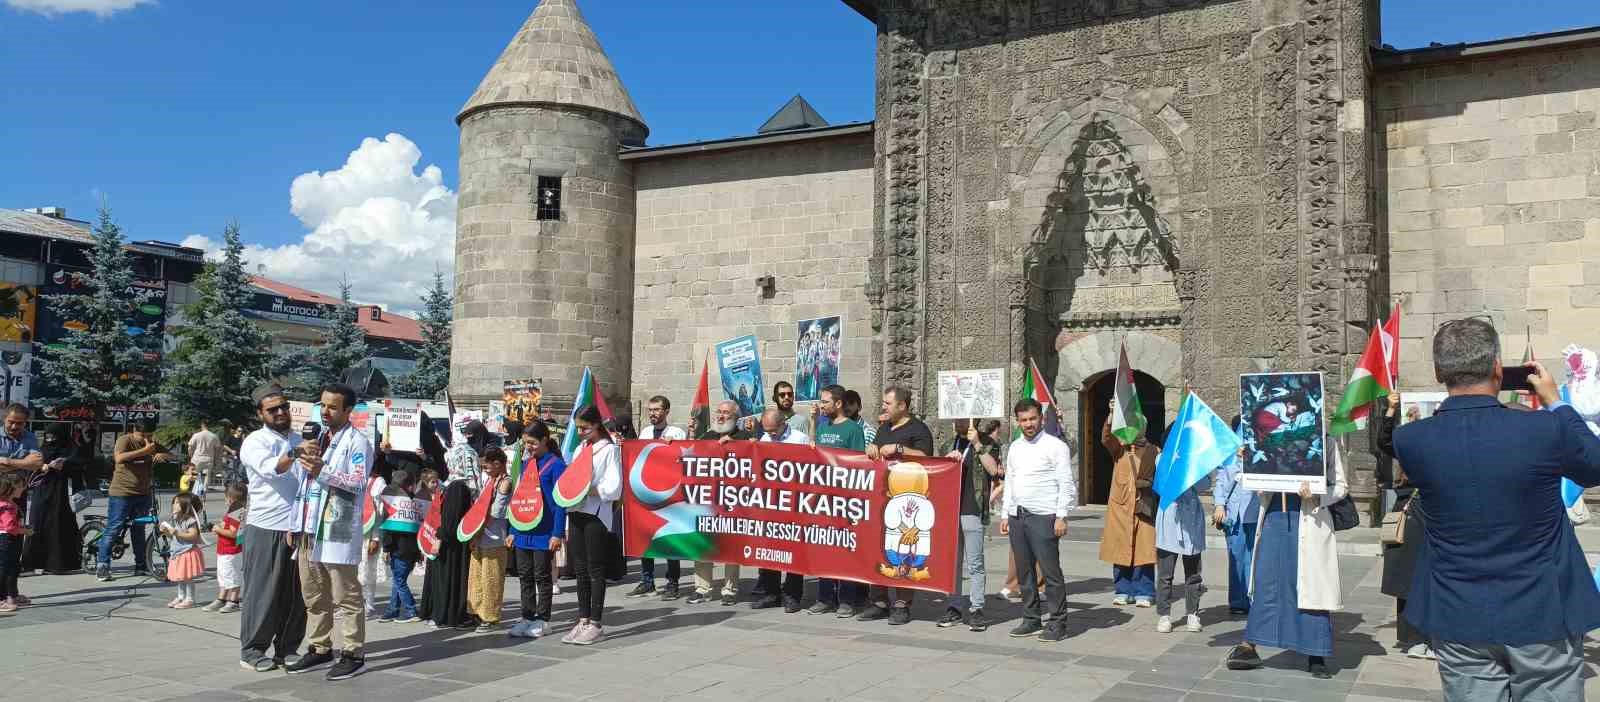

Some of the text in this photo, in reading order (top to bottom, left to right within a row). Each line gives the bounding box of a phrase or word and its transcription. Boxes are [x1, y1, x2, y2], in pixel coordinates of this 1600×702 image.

[683, 453, 876, 491] TERÖR, SOYKIRIM
[684, 481, 869, 526] VE İŞGALE KARŞI
[766, 522, 802, 542] SESSİZ
[803, 524, 857, 552] YÜRÜYÜŞ
[755, 547, 793, 564] ERZURUM
